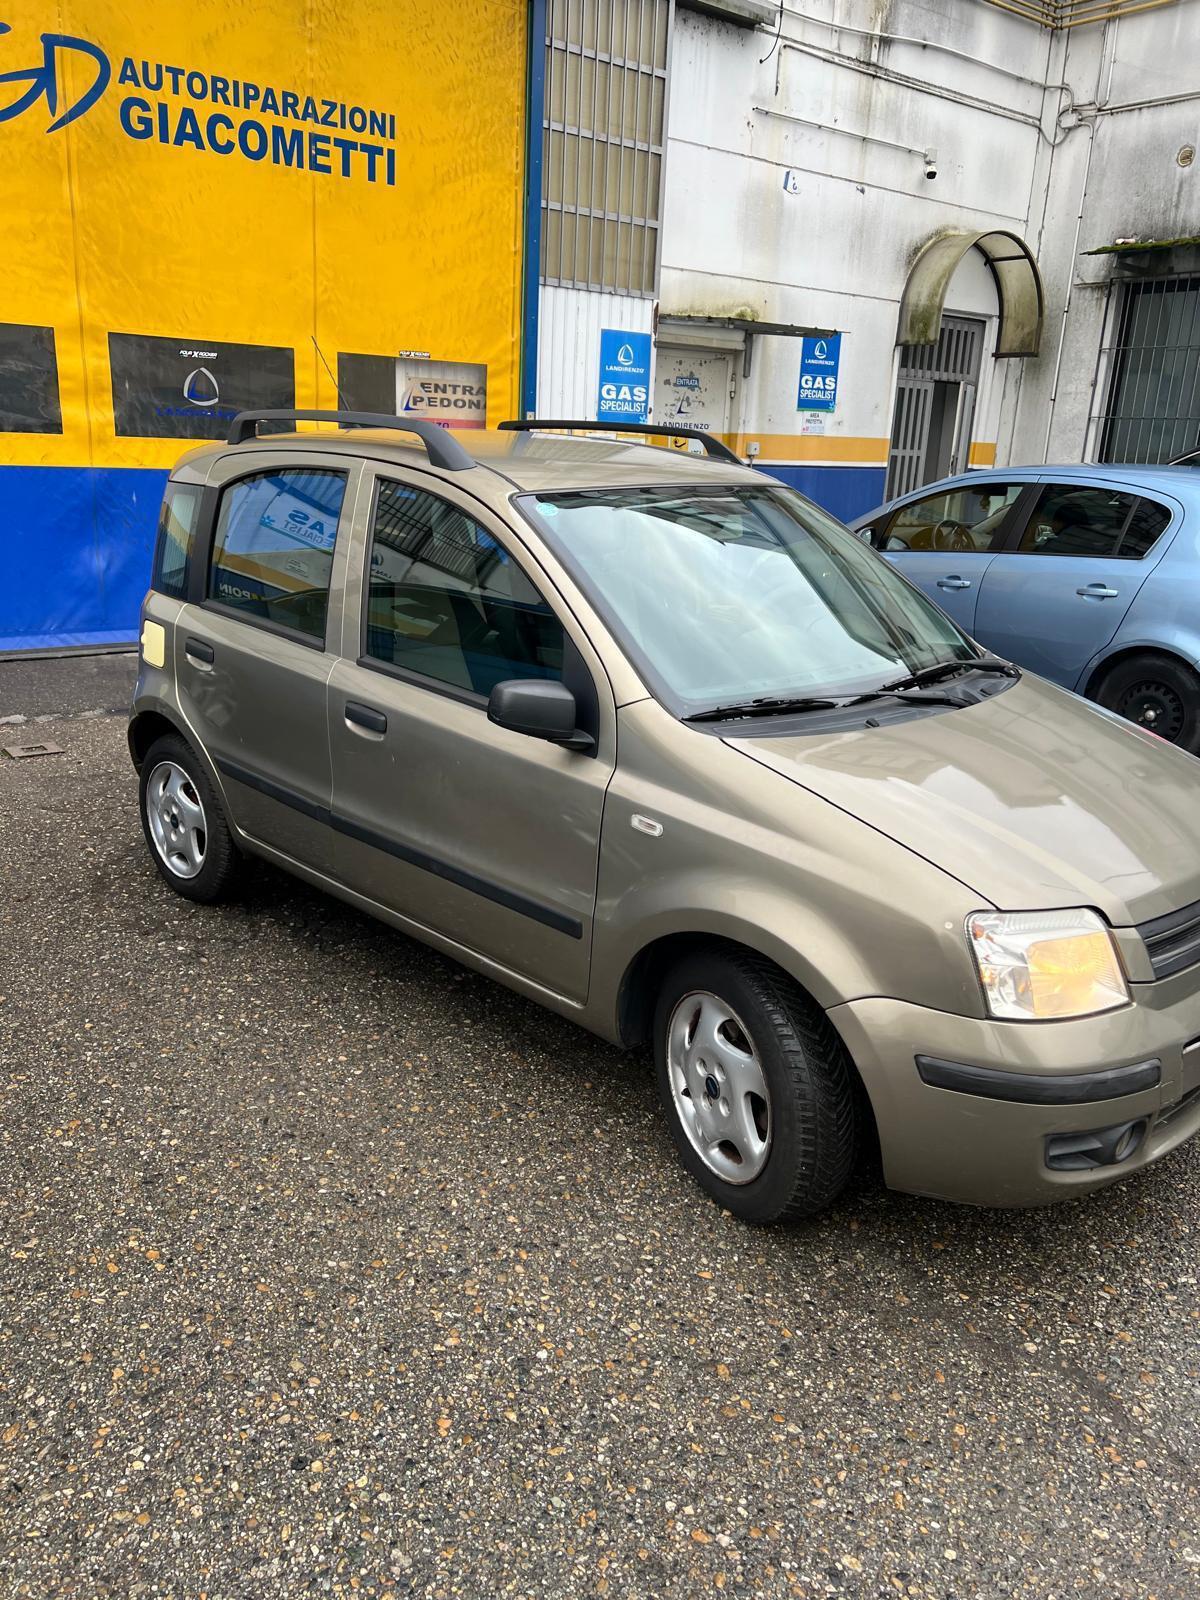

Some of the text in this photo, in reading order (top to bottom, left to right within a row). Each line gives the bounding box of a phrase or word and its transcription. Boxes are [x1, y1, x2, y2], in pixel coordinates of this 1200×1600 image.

[118, 57, 396, 140] AUTORIPARAZIONI
[119, 96, 396, 186] GIACOMETTI
[805, 358, 835, 366] LANDIRENZO
[605, 365, 645, 374] LANDIRENZO
[676, 378, 698, 387] ENTRATA
[801, 375, 836, 390] GAS
[601, 384, 647, 402] GAS
[800, 389, 835, 399] SPECIALIST
[412, 396, 486, 410] PEDON
[600, 400, 646, 413] SPECIALIST
